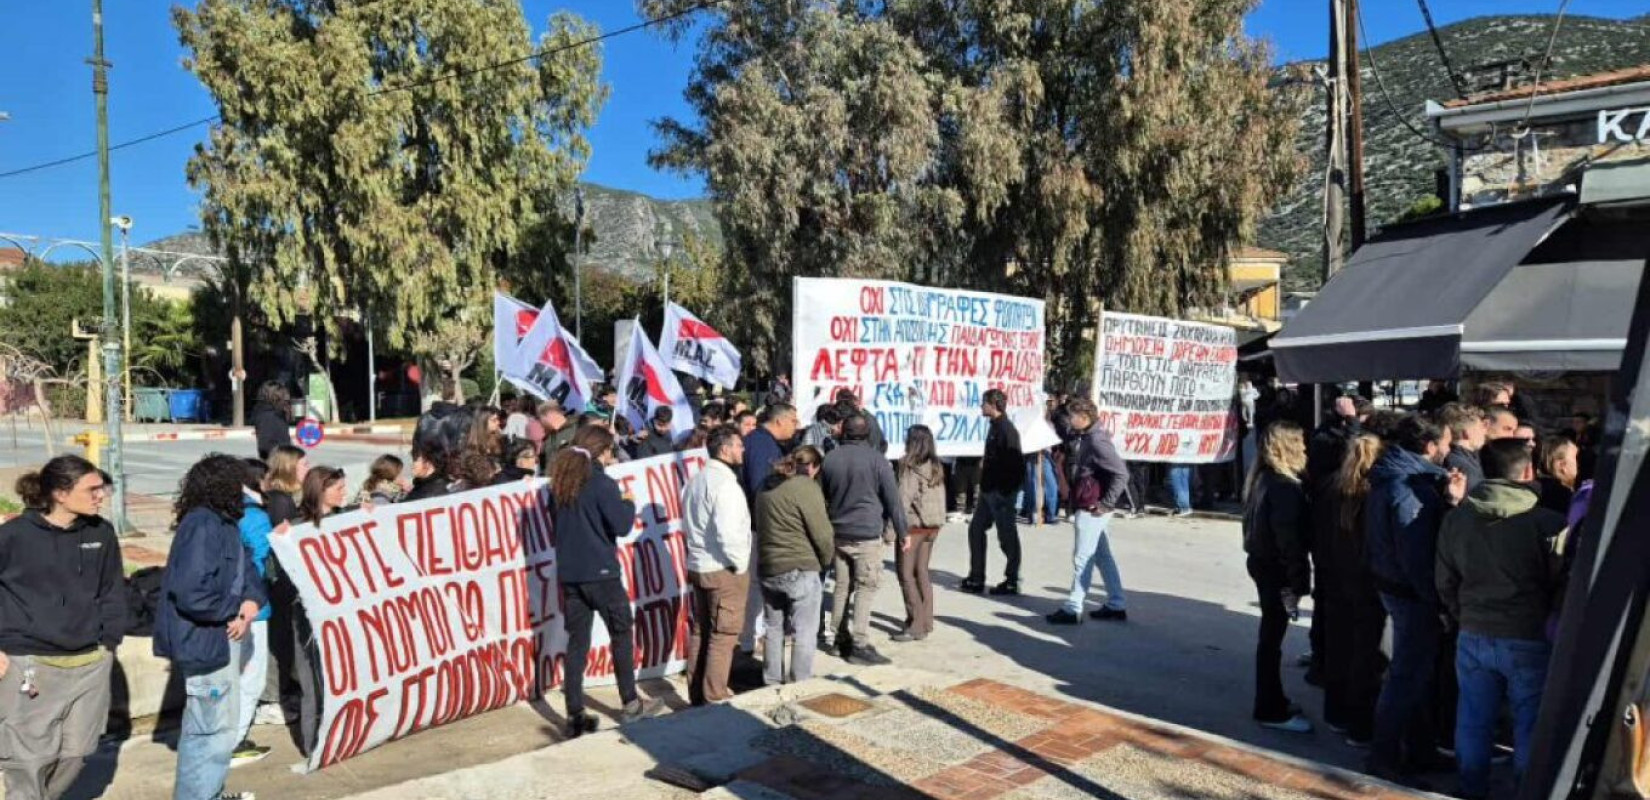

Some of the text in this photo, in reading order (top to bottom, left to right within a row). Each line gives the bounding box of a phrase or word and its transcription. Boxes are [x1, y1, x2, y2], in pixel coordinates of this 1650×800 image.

[859, 286, 884, 314] ΟΧΙ
[829, 317, 858, 343] ΟΧΙ
[810, 348, 899, 382] ΛΕΦΤΑ
[932, 346, 978, 377] ΤΗΝ
[299, 520, 404, 605] ΟΥΤΕ
[321, 617, 358, 697] ΟΙ
[357, 586, 456, 683] ΝΟΜΟΙ
